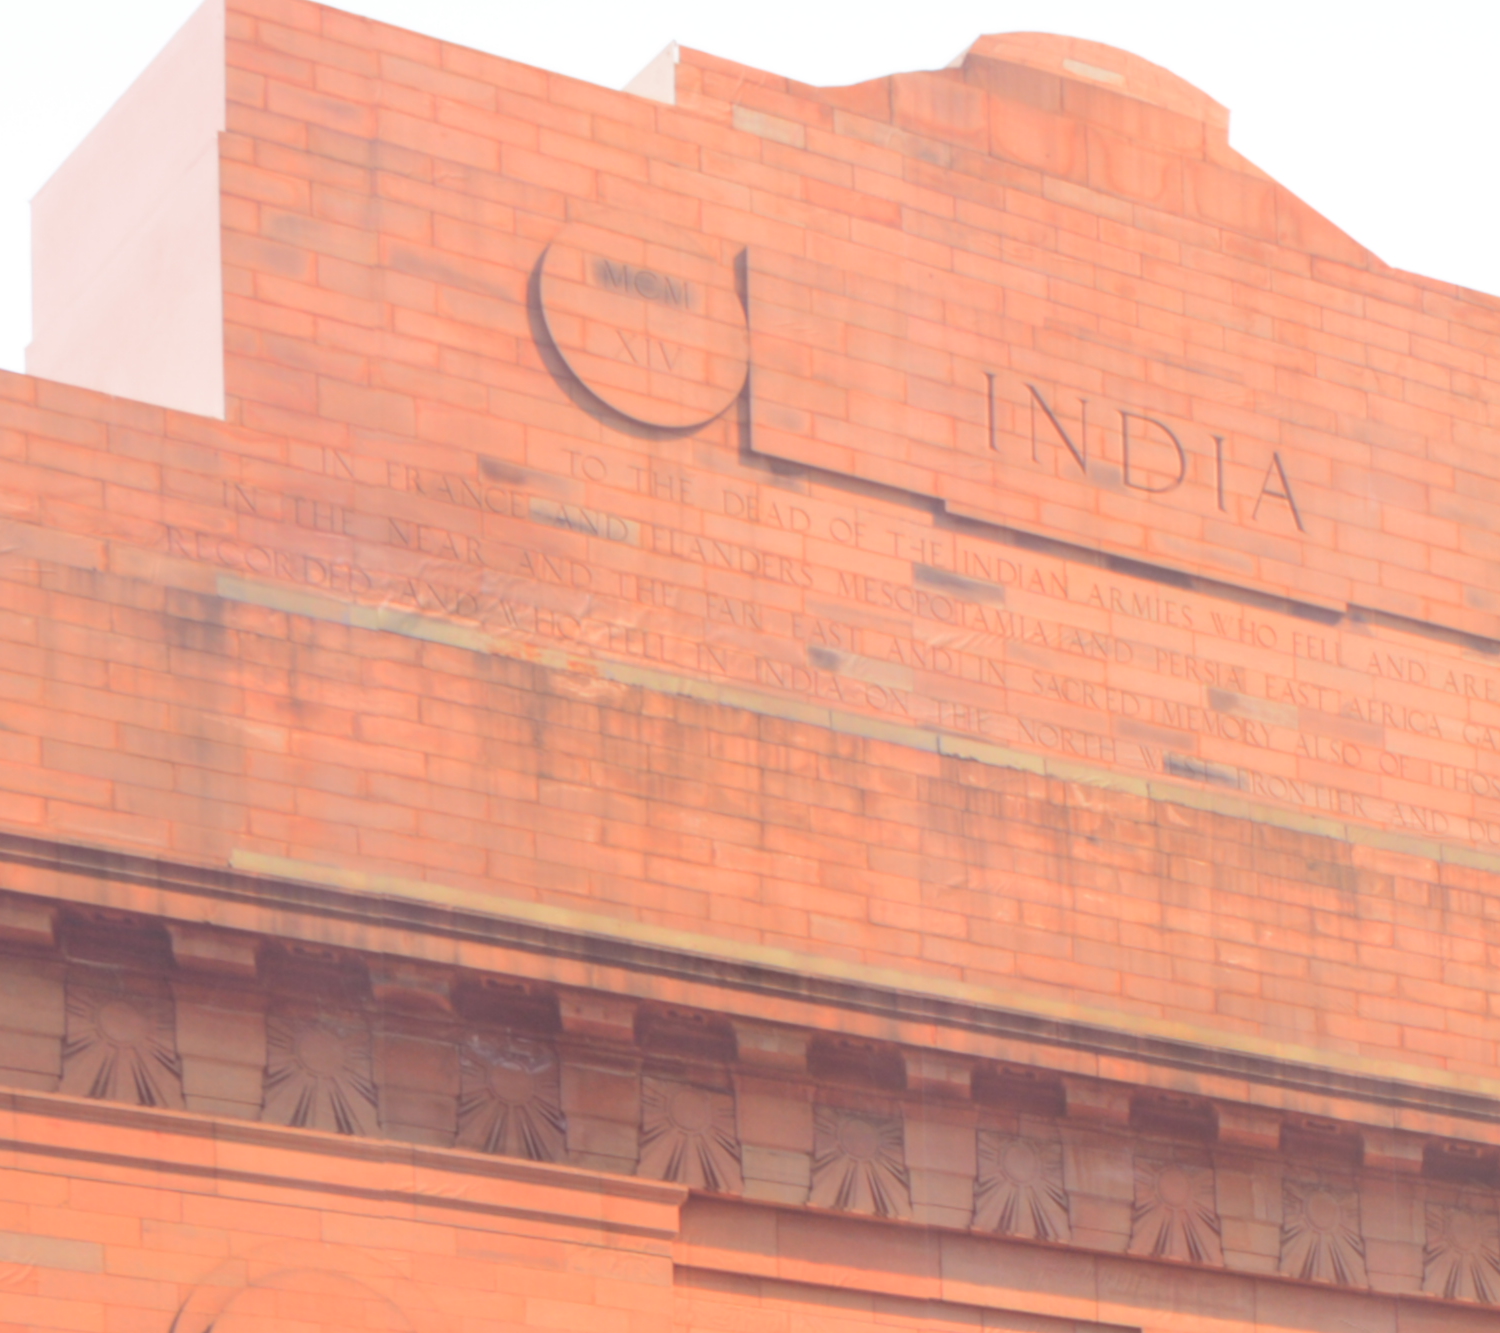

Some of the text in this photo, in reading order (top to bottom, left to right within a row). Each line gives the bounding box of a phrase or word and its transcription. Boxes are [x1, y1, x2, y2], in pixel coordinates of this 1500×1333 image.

[601, 258, 690, 311] MCM
[614, 328, 684, 373] XIV
[560, 448, 606, 484] TO
[627, 466, 692, 506] THE
[722, 489, 811, 535] DEAD
[828, 515, 865, 548] OF
[887, 531, 944, 567] THE
[963, 550, 1068, 600] INDIAN
[1088, 580, 1193, 629] ARMIES
[1210, 610, 1277, 649] WHO
[1291, 630, 1340, 666] FELL
[1367, 649, 1426, 687] AND
[1442, 668, 1496, 704] ARE
[982, 370, 1307, 535] INDIA
[168, 525, 372, 599] RECORDED
[401, 576, 479, 623] AND
[497, 597, 583, 644] WHO
[608, 623, 675, 665] FELL
[696, 642, 727, 677] IN
[755, 656, 844, 703] INDIA
[936, 698, 987, 735] THE
[1015, 717, 1116, 764] NORTH
[1237, 767, 1364, 819] FRONTIER
[1390, 800, 1452, 839] AND
[221, 478, 257, 513] IN
[296, 496, 353, 536] THE
[388, 518, 482, 566] NEAR
[518, 549, 592, 592] AND
[620, 573, 675, 611] THE
[707, 593, 761, 631] FAR
[792, 613, 862, 654] EAST
[888, 636, 953, 676] AND
[977, 656, 1005, 688] IN
[1032, 668, 1141, 719] SACRED
[1161, 699, 1272, 750] MEMORY
[1294, 730, 1362, 769] ALSO
[1379, 750, 1410, 780] OF
[320, 446, 354, 480] IN
[386, 461, 523, 520] FRANCE
[553, 501, 629, 545] AND
[651, 525, 813, 589] FLANDERS
[837, 570, 1049, 646] MESOPOTAMIA
[1067, 626, 1133, 666] AND
[1156, 647, 1241, 691] PERSIA
[1264, 674, 1323, 711] EAST
[1349, 694, 1442, 739] AFRICA
